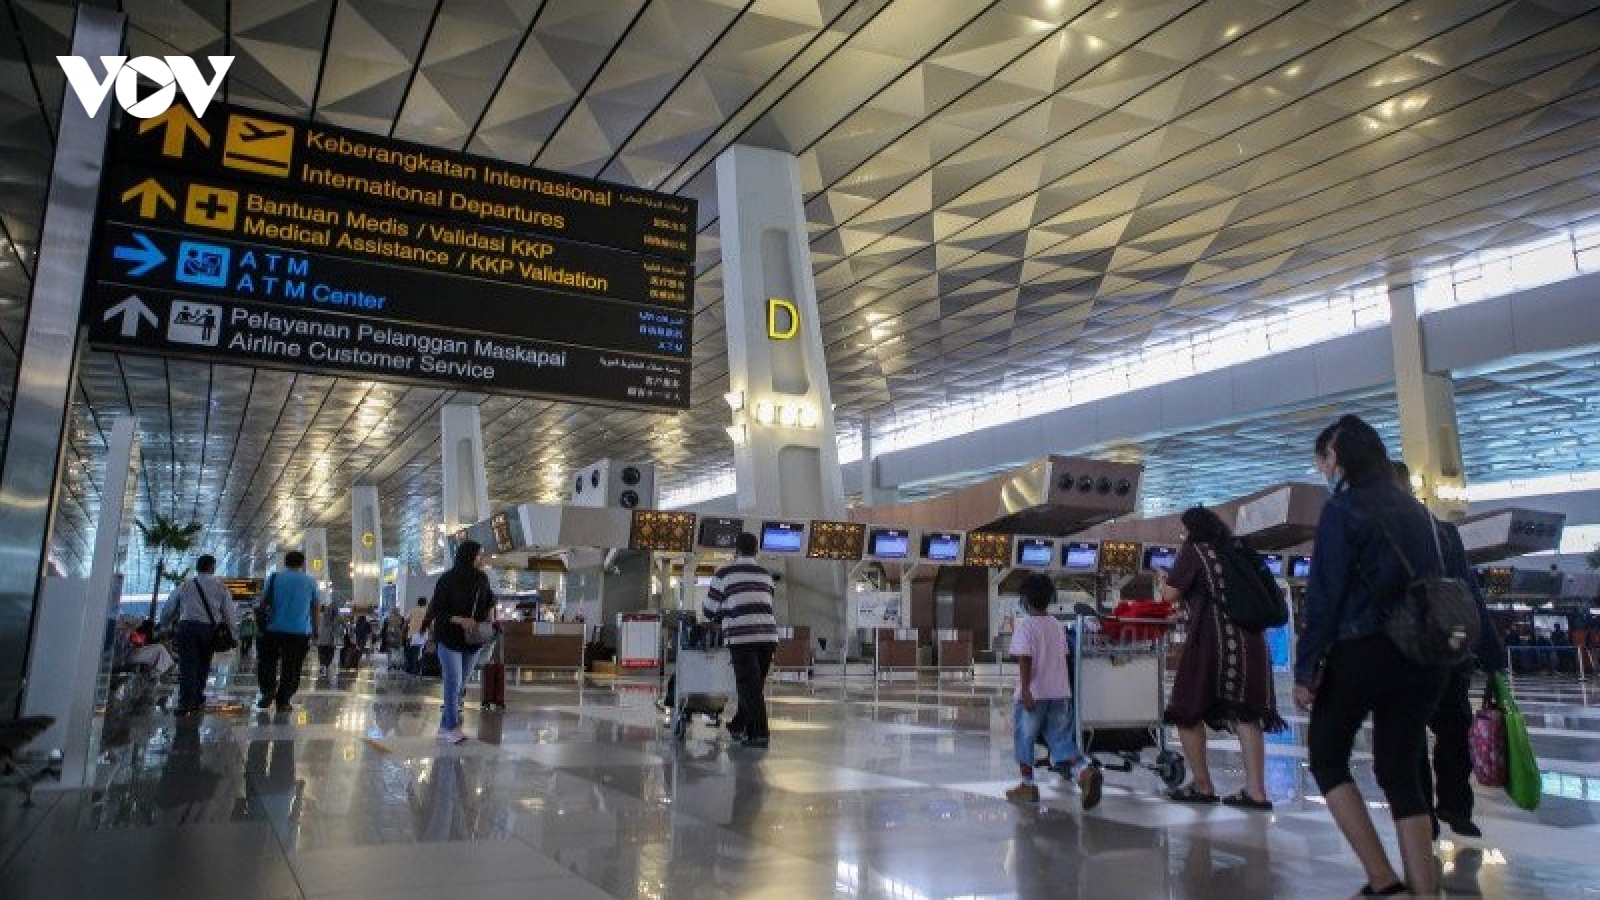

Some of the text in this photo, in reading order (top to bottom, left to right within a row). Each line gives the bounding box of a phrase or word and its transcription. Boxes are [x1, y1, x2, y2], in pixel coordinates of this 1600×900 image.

[302, 163, 565, 229] International Departures
[306, 130, 476, 179] Keberangkatan
[484, 165, 611, 206] Internasional
[244, 216, 330, 247] Medical
[336, 231, 449, 265] Assistance
[470, 253, 514, 274] KKP
[519, 261, 609, 291] Validation
[247, 194, 339, 225] Bantuan
[347, 210, 409, 237] Medis
[429, 224, 505, 253] Validasi
[511, 237, 553, 259] KKP
[312, 284, 387, 311] Center
[766, 298, 799, 340] D
[228, 331, 495, 379] Airline Customer Service
[231, 307, 350, 339] Pelayanan
[358, 323, 467, 355] Pelanggan
[475, 338, 567, 368] Maskapai
